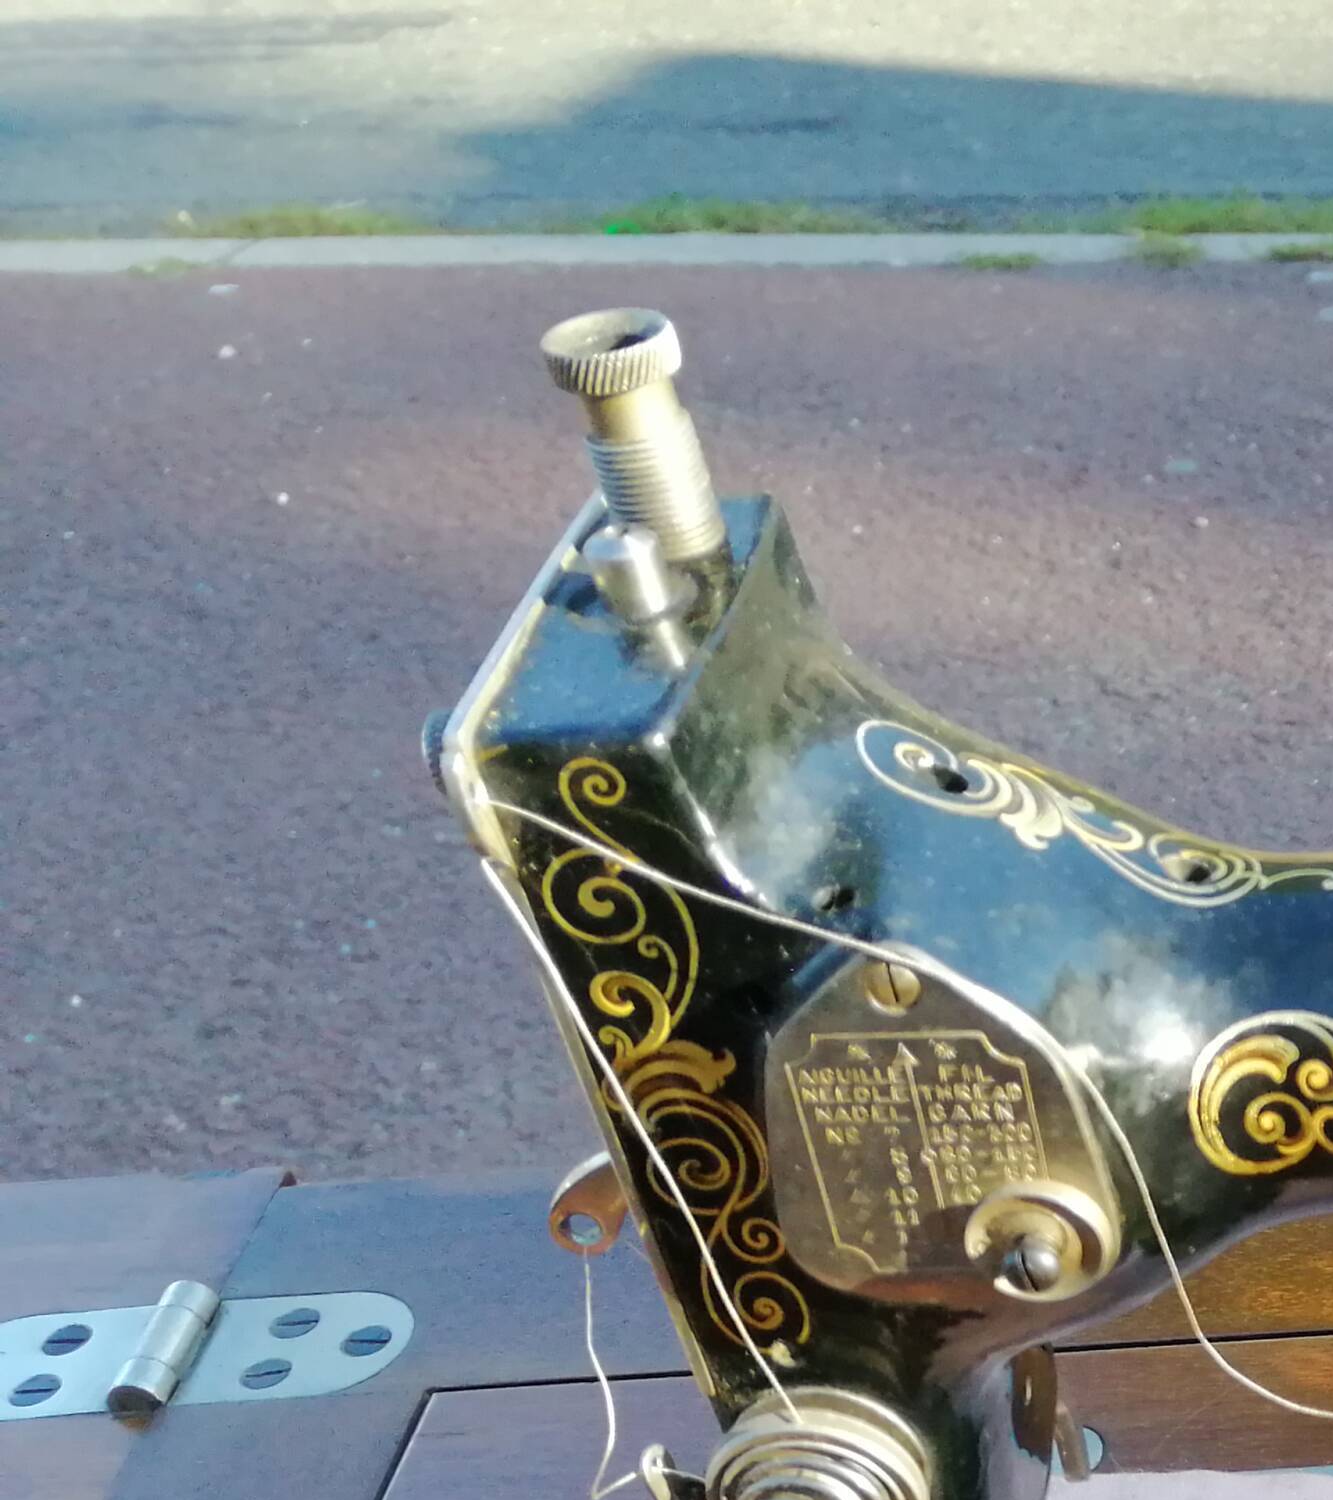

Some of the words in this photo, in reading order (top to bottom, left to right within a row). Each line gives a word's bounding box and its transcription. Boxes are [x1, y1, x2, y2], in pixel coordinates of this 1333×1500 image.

[798, 1065, 905, 1085] AIGUILLE
[938, 1063, 997, 1083] FIL
[800, 1086, 911, 1104] NEEDLE
[917, 1082, 1023, 1103] THREAD
[814, 1104, 911, 1123] NADEL
[928, 1102, 1015, 1122] GARN
